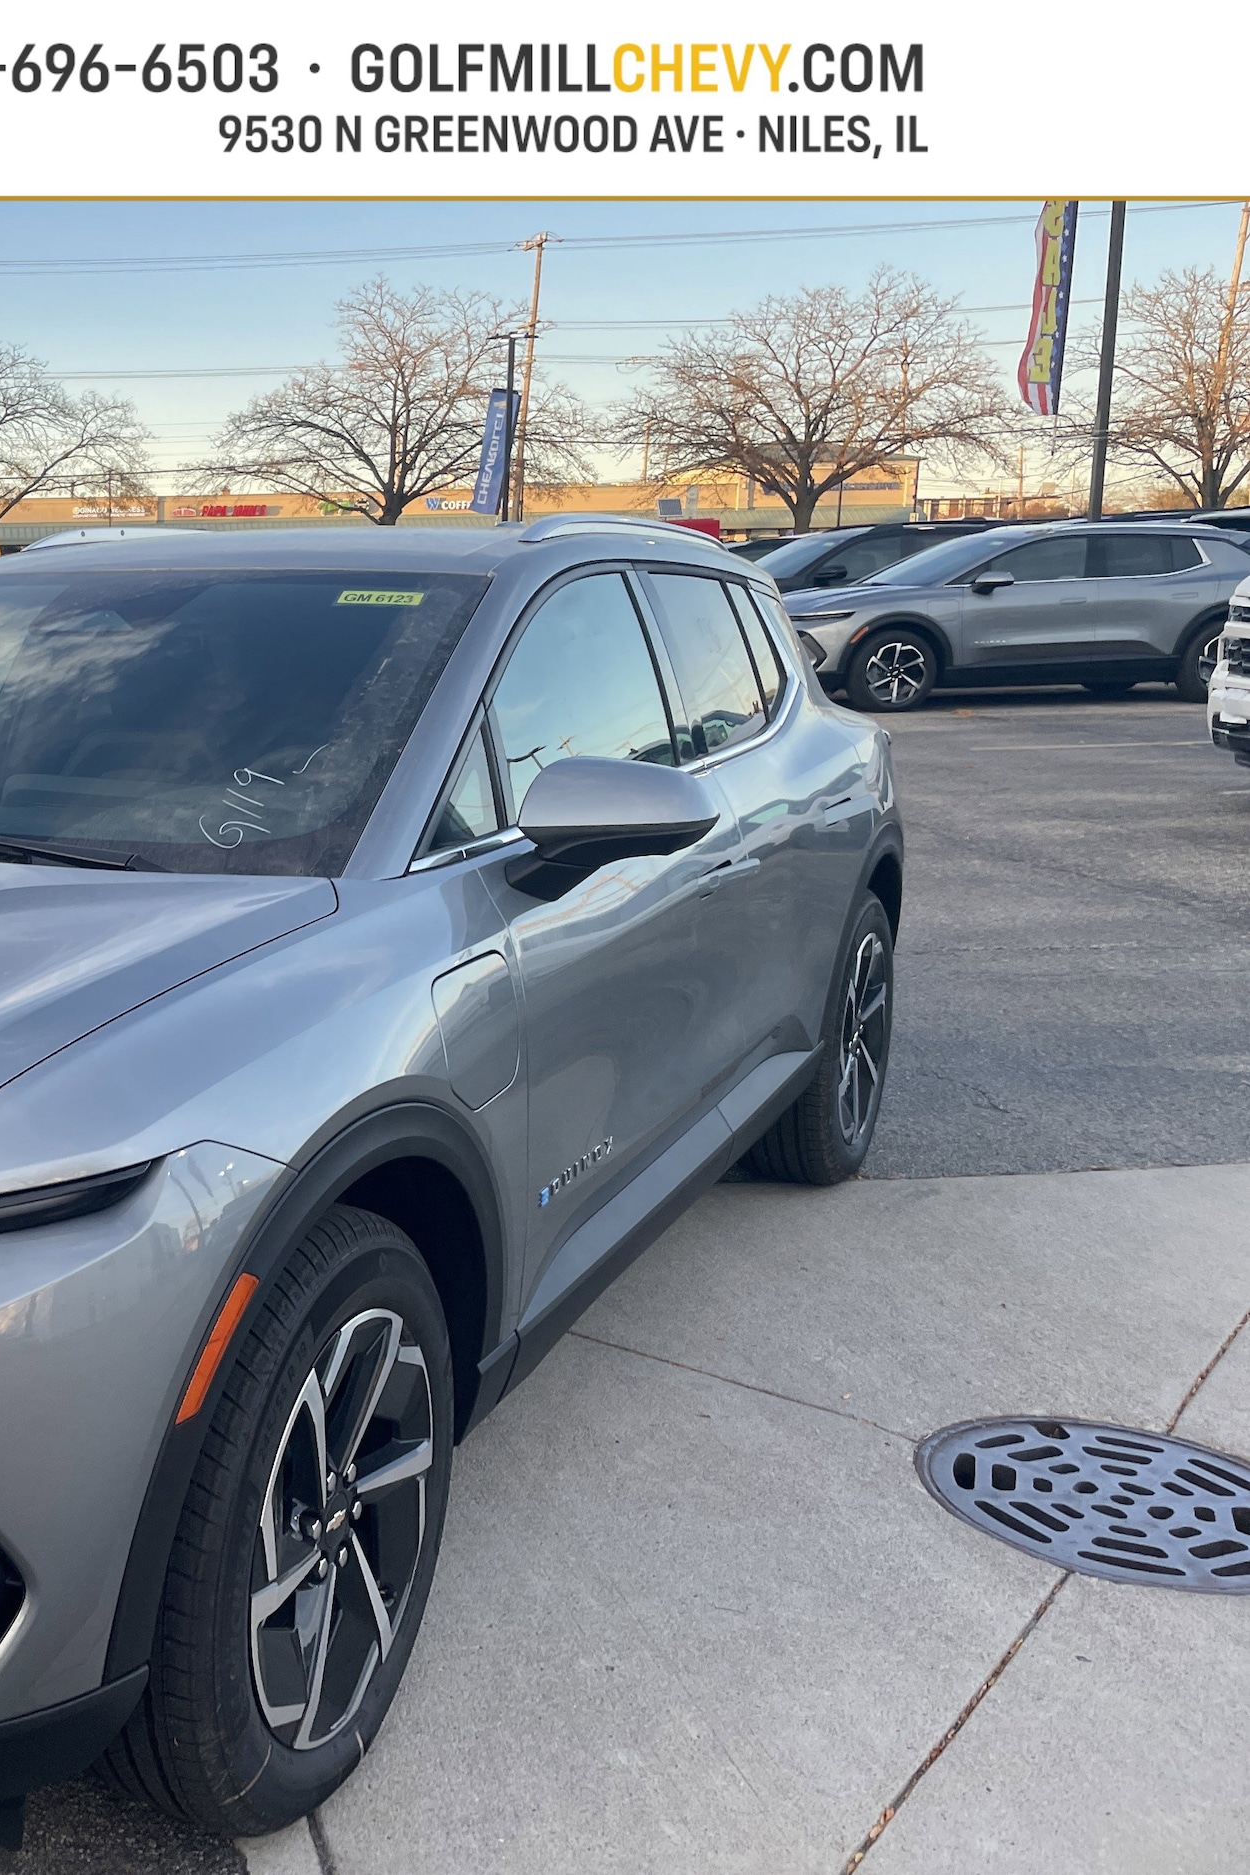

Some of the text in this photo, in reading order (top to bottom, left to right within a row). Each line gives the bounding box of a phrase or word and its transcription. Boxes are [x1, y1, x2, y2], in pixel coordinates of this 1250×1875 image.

[343, 593, 414, 604] GM 6123
[539, 1135, 614, 1208] EQUINOX
